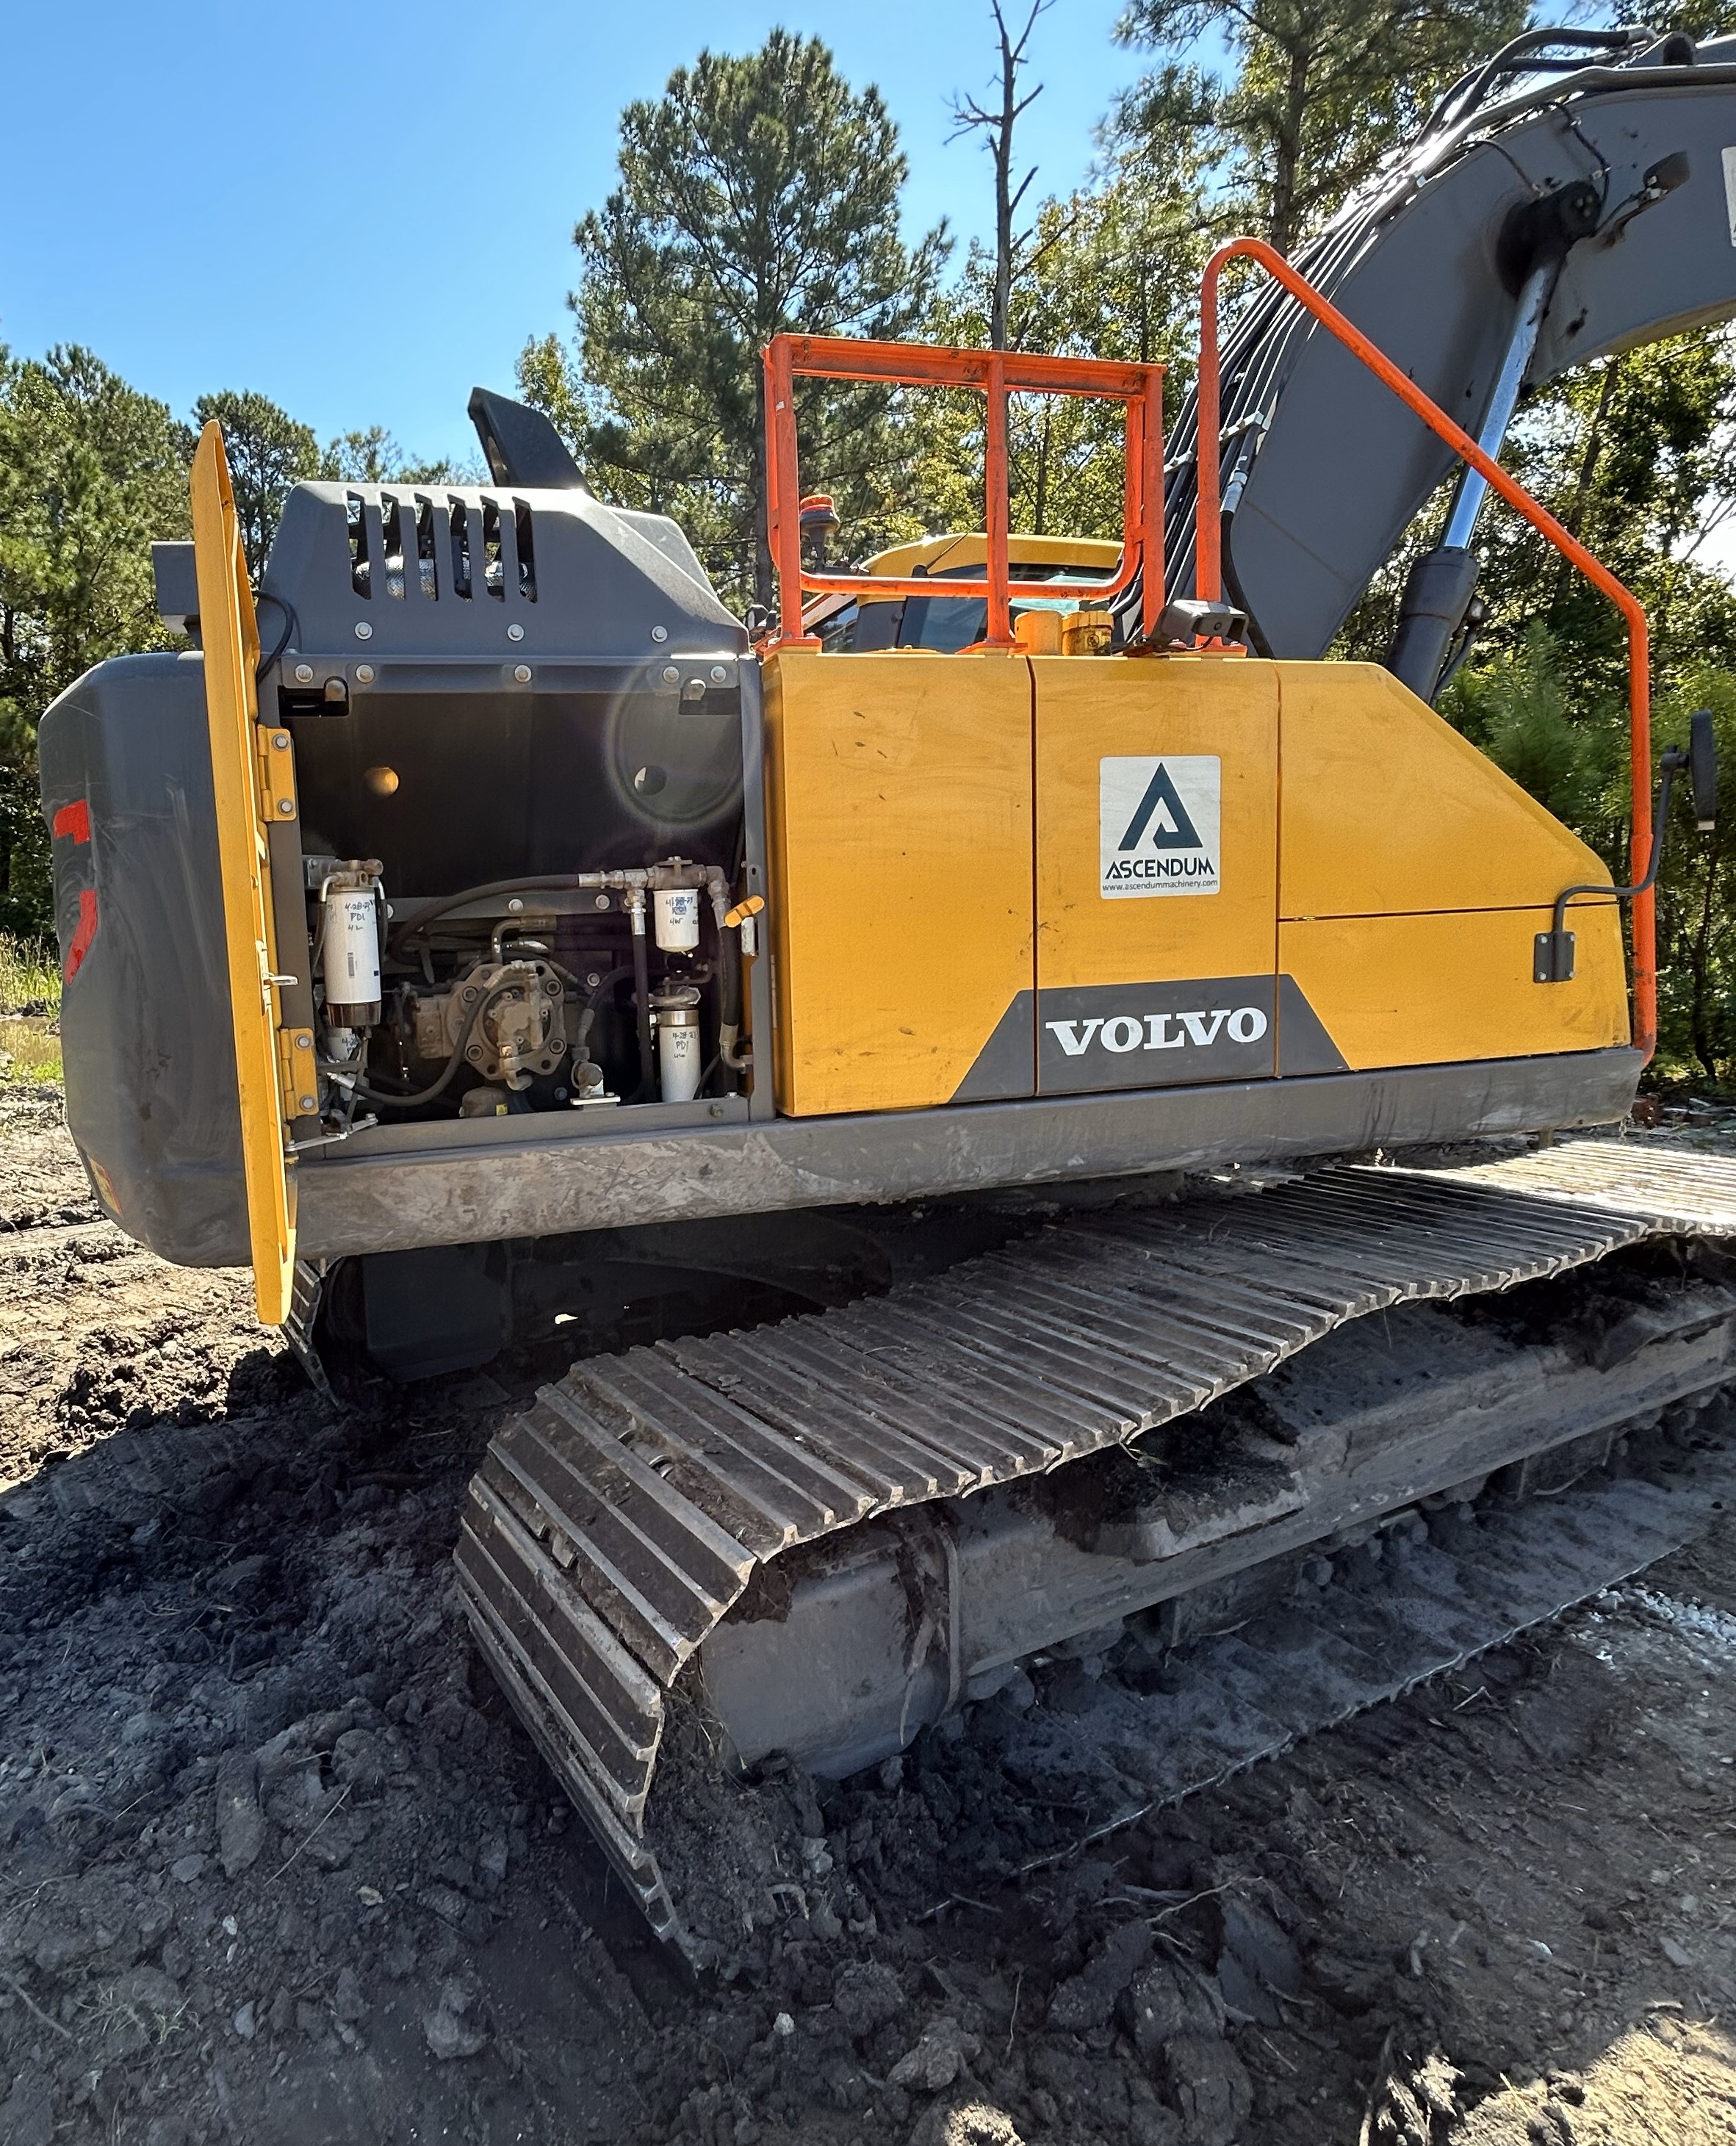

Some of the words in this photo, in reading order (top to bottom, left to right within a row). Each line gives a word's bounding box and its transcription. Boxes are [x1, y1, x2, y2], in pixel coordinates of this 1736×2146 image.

[1105, 857, 1215, 879] ASCENDUM
[1102, 879, 1218, 891] www.ascendummachinery.com
[1045, 1007, 1267, 1056] VOLVO
